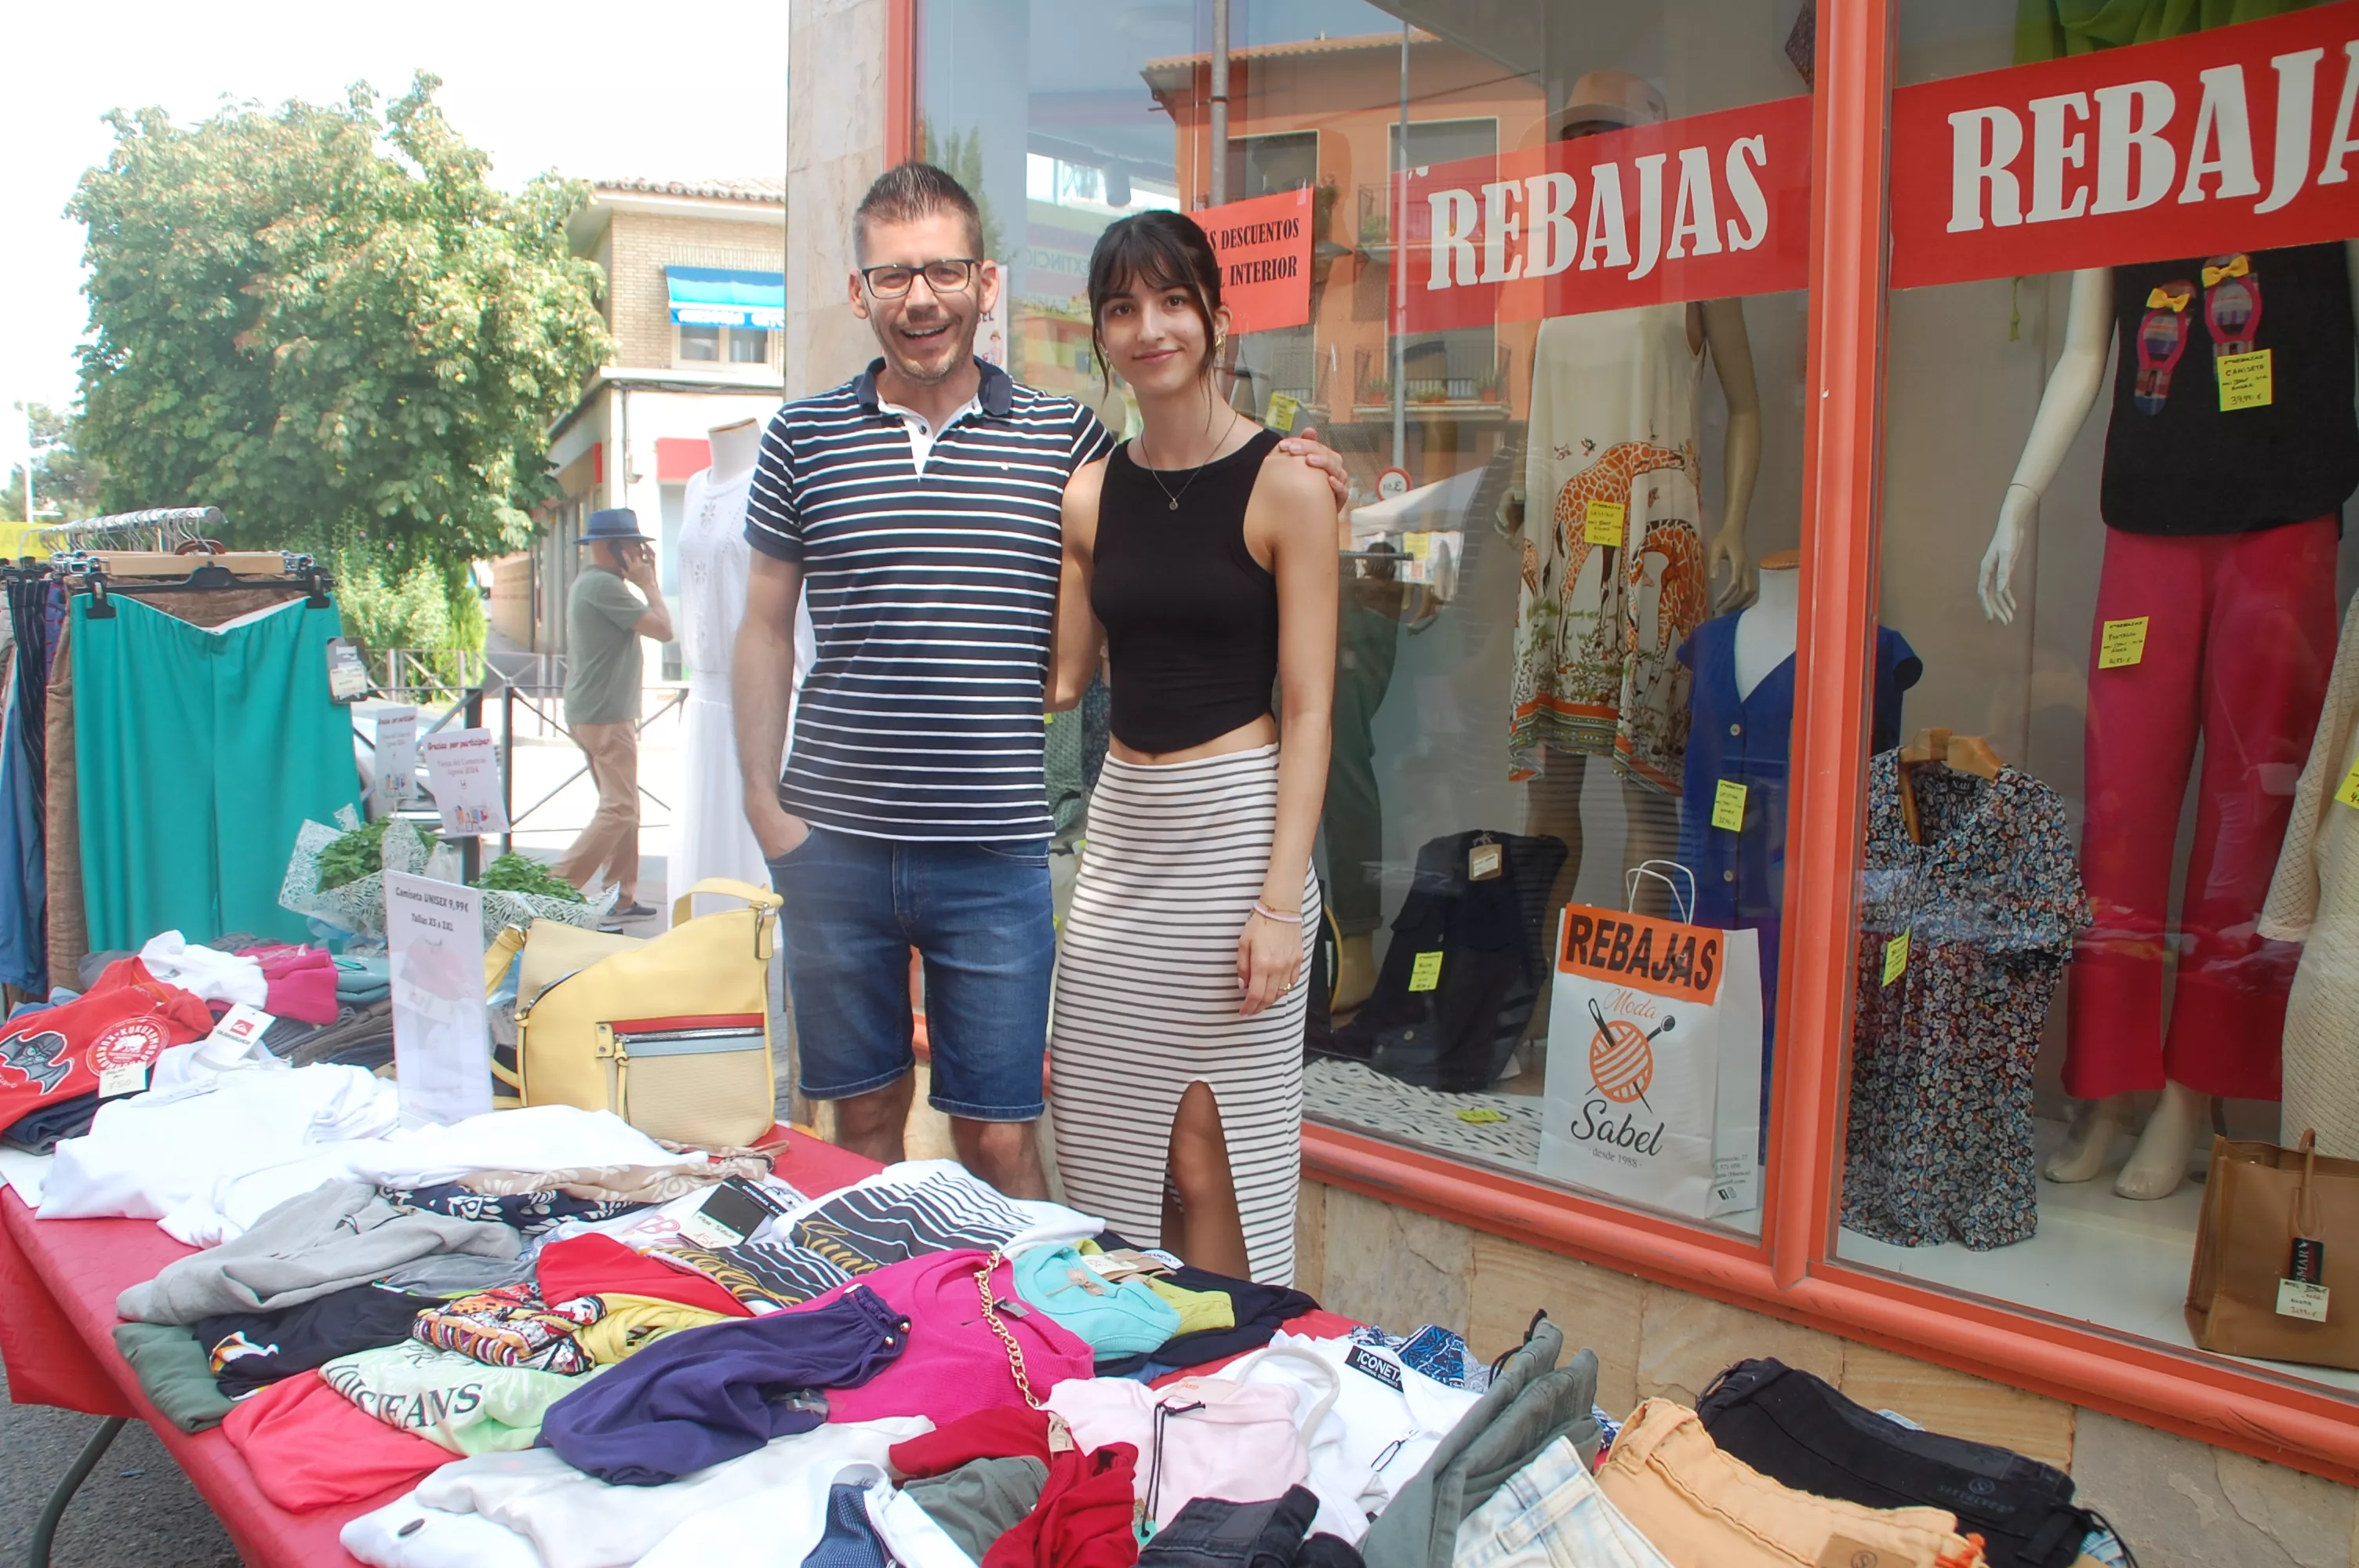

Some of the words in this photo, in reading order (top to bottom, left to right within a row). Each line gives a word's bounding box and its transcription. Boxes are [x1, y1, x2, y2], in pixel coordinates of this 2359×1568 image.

[1427, 134, 1768, 291] REBAJAS
[1221, 217, 1299, 250] DESCUENTOS
[1230, 255, 1298, 286] INTERIOR
[427, 742, 447, 750] Gracias
[449, 742, 459, 750] por
[460, 739, 491, 750] participar
[395, 887, 422, 902] Camiseta
[424, 894, 447, 907] UNISEX
[449, 898, 469, 913] 9,99€
[412, 913, 427, 925] Tallas
[1566, 913, 1717, 991] REBAJAS
[1604, 988, 1659, 1019] Moda
[1571, 1099, 1665, 1156] Sabel
[1592, 1147, 1616, 1162] desde
[1617, 1154, 1638, 1168] 1988
